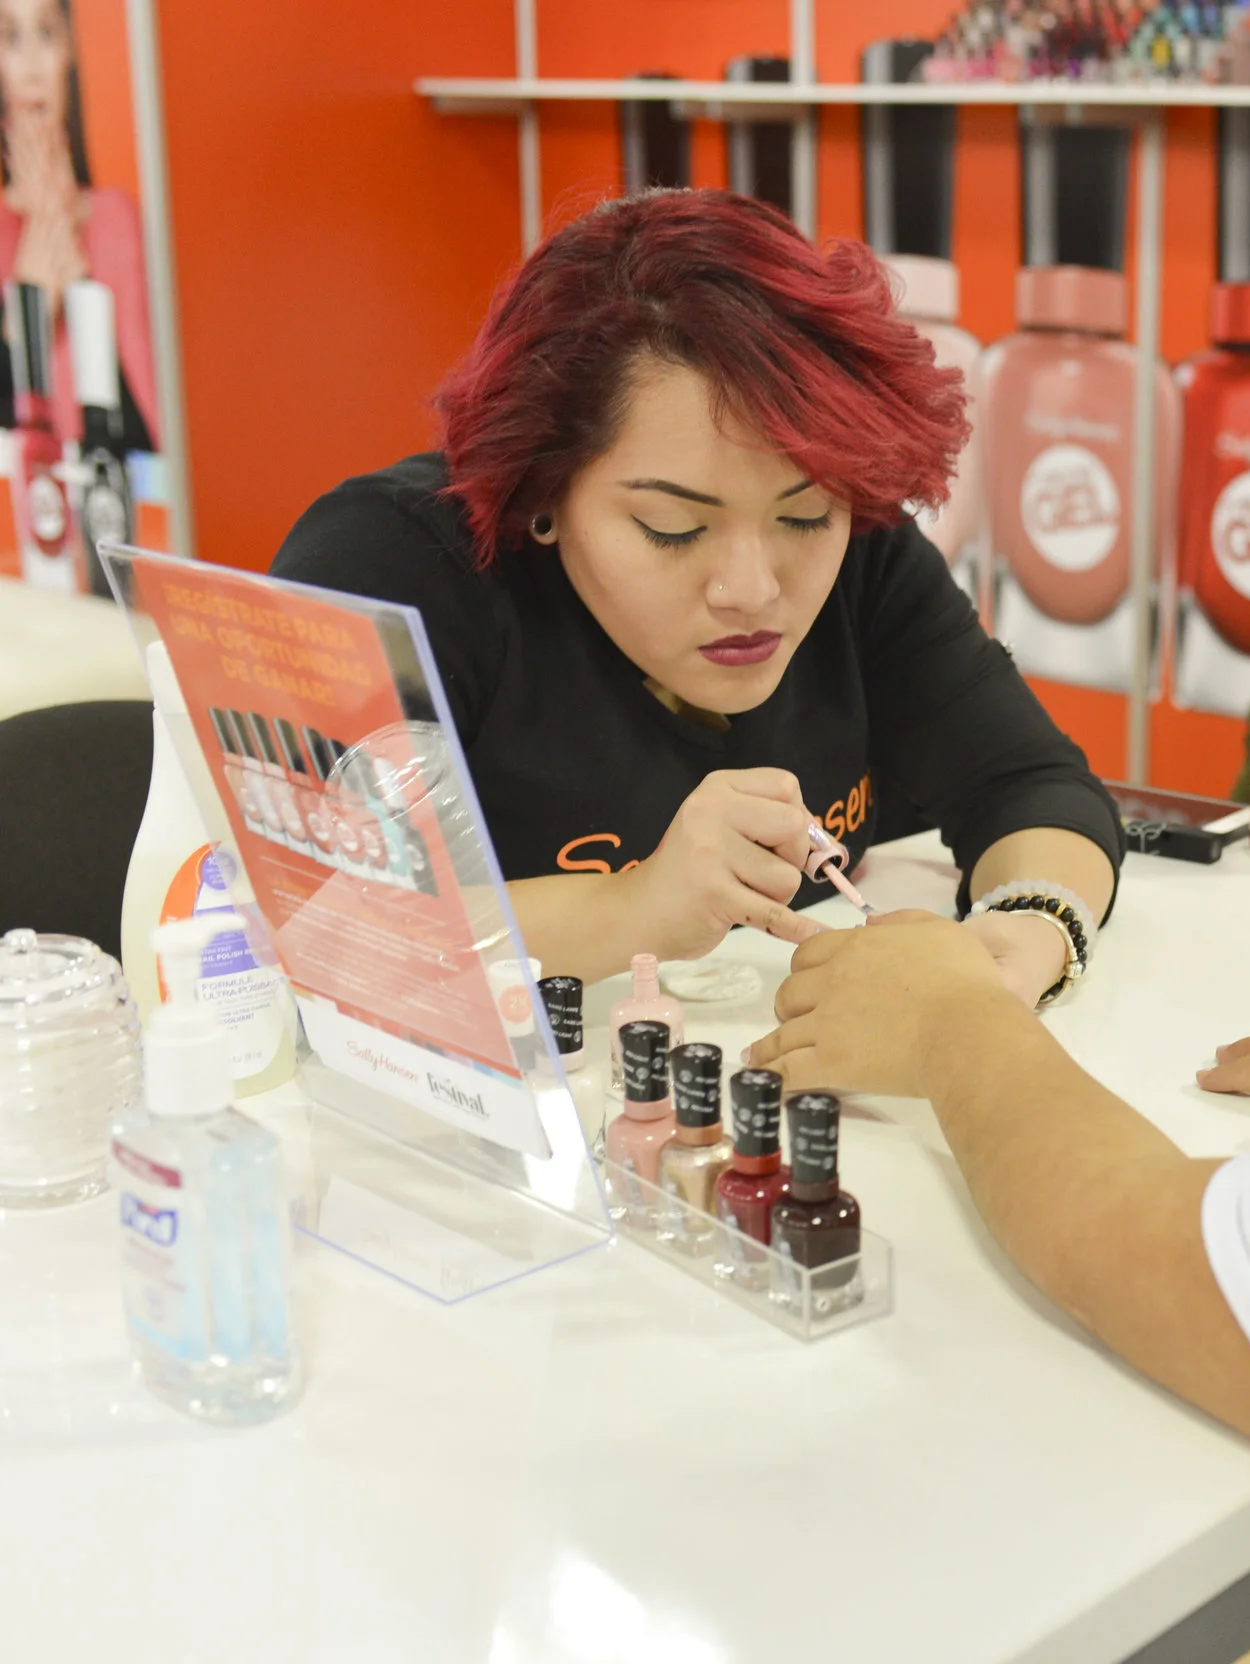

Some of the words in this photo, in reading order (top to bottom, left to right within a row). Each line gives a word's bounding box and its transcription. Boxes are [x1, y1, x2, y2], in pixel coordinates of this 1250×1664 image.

[1034, 484, 1119, 533] GEL
[169, 612, 215, 644] UNA
[216, 626, 372, 685] OPORTUNIDAD
[292, 617, 358, 652] PARA
[221, 655, 250, 682] DE
[202, 976, 252, 992] FORMULE
